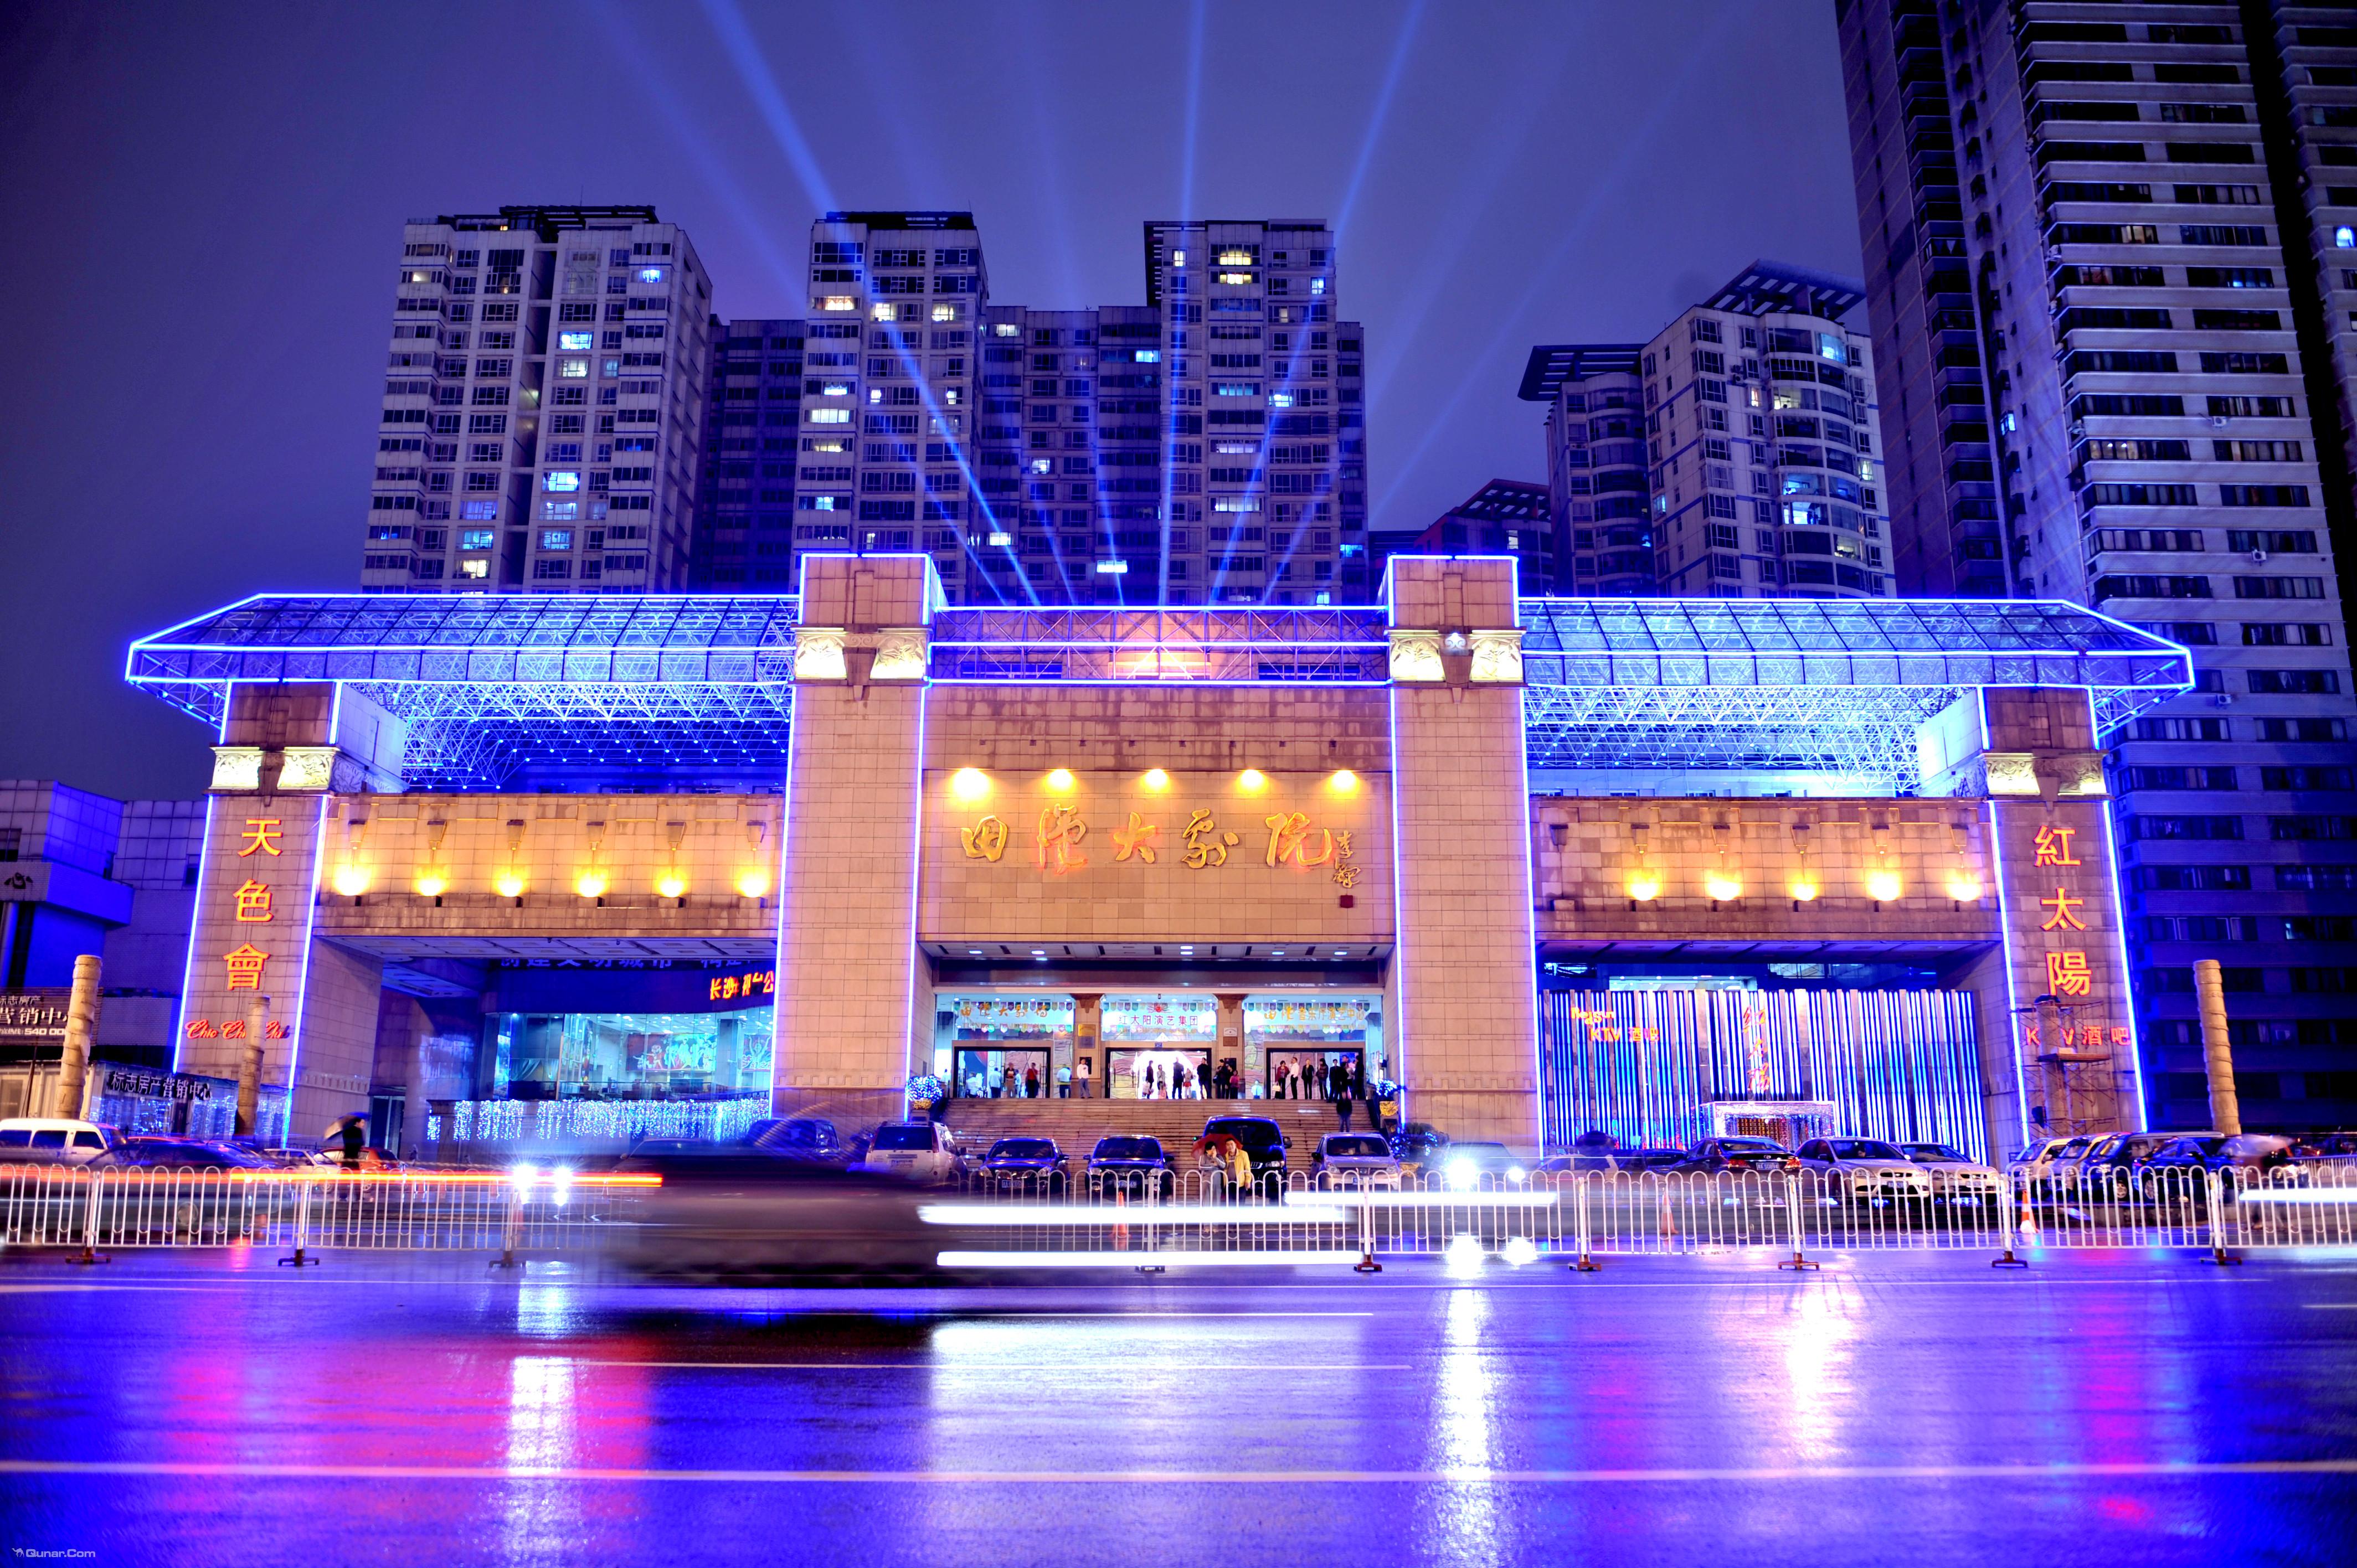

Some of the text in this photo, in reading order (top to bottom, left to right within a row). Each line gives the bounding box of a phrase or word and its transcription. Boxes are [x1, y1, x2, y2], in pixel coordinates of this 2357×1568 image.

[223, 818, 283, 991] 天色會
[2034, 825, 2092, 996] 紅太陽
[0, 1007, 68, 1024] 营销中
[1119, 1015, 1198, 1026] 红太阳演艺集团
[1590, 1027, 1622, 1042] KTV
[112, 1071, 212, 1100] 标志房产营销中心
